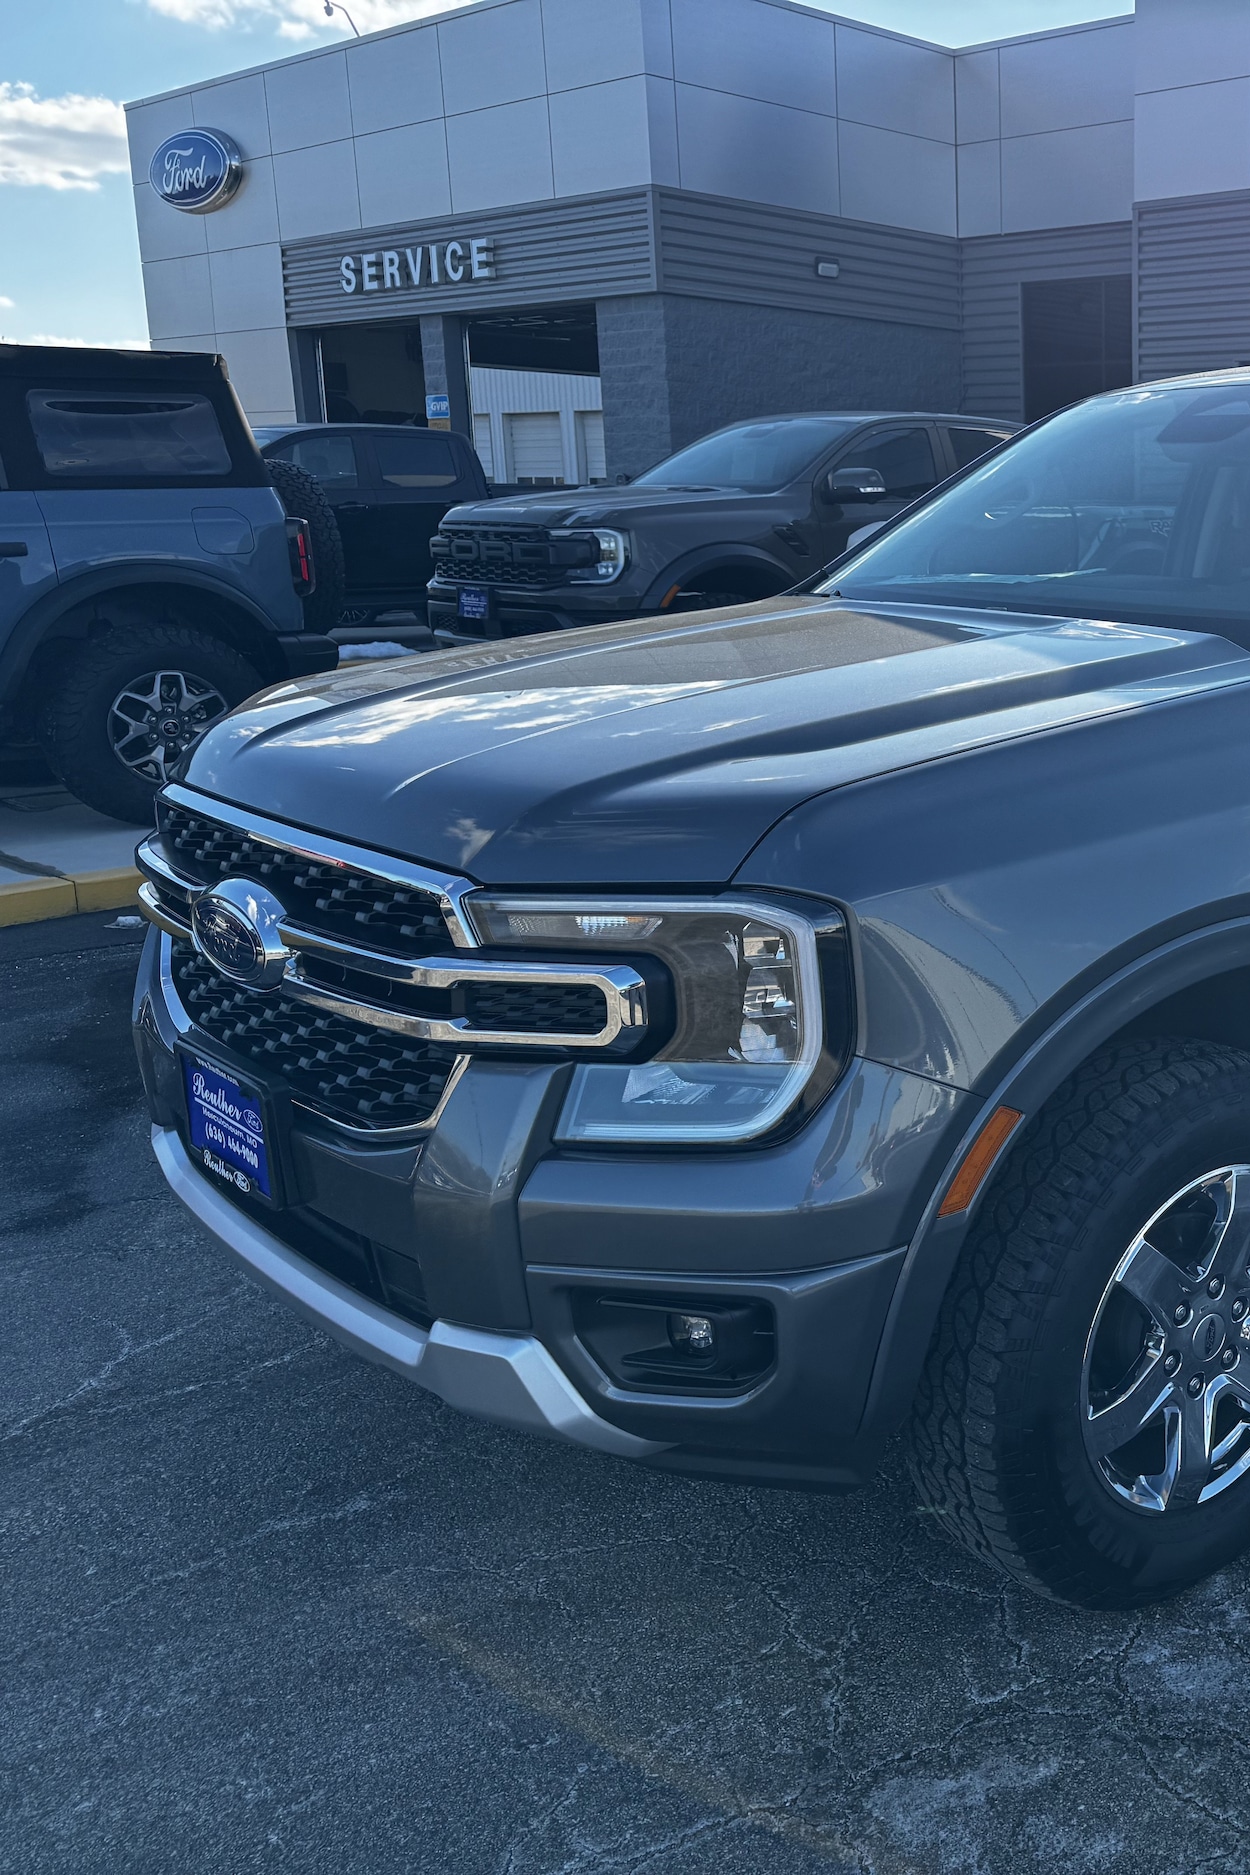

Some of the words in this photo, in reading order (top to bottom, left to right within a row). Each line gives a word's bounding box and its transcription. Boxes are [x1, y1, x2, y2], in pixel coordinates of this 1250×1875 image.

[163, 148, 207, 194] Ford
[340, 237, 494, 293] SERVICE
[429, 536, 549, 564] FORD
[192, 1072, 242, 1121] Reuther
[205, 1122, 226, 1149] (636)
[203, 1149, 234, 1183] Reuther
